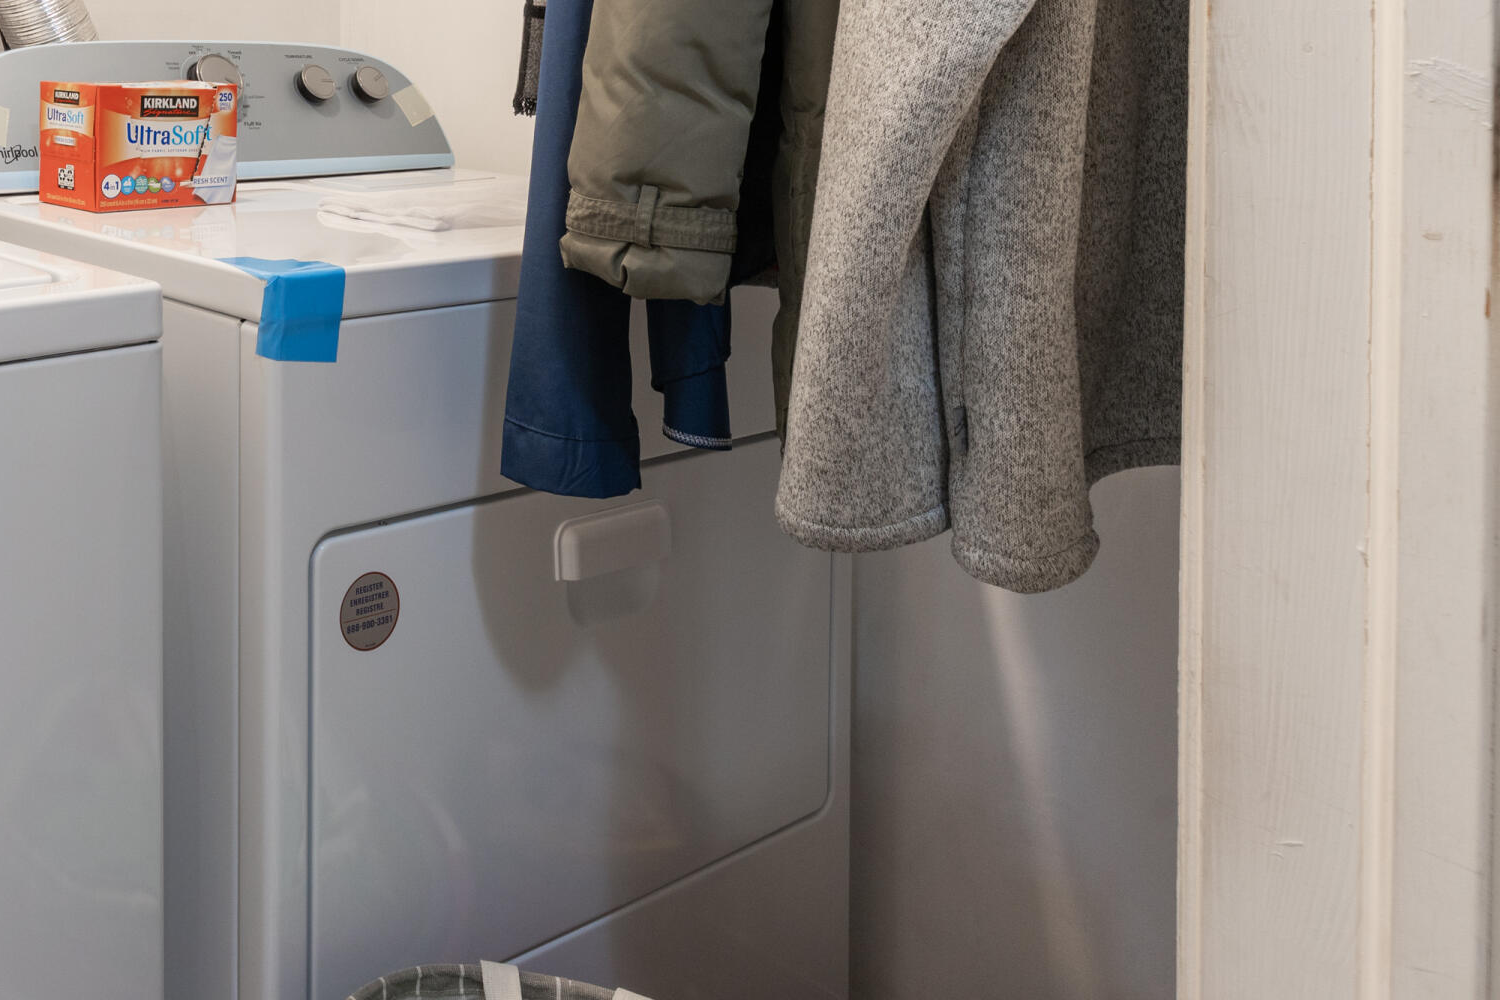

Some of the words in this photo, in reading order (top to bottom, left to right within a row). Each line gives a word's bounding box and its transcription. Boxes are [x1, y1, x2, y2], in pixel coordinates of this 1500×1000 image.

[55, 91, 80, 100] KIRKLAND
[143, 97, 198, 109] KIRKLAND
[219, 92, 233, 102] 250
[47, 107, 84, 125] UltraSoft
[126, 122, 212, 146] UltraSoft
[209, 176, 228, 184] SCENT
[355, 581, 384, 596] REGISTER
[350, 590, 389, 608] ENREGISTRER
[346, 614, 393, 635] 888-900-3381
